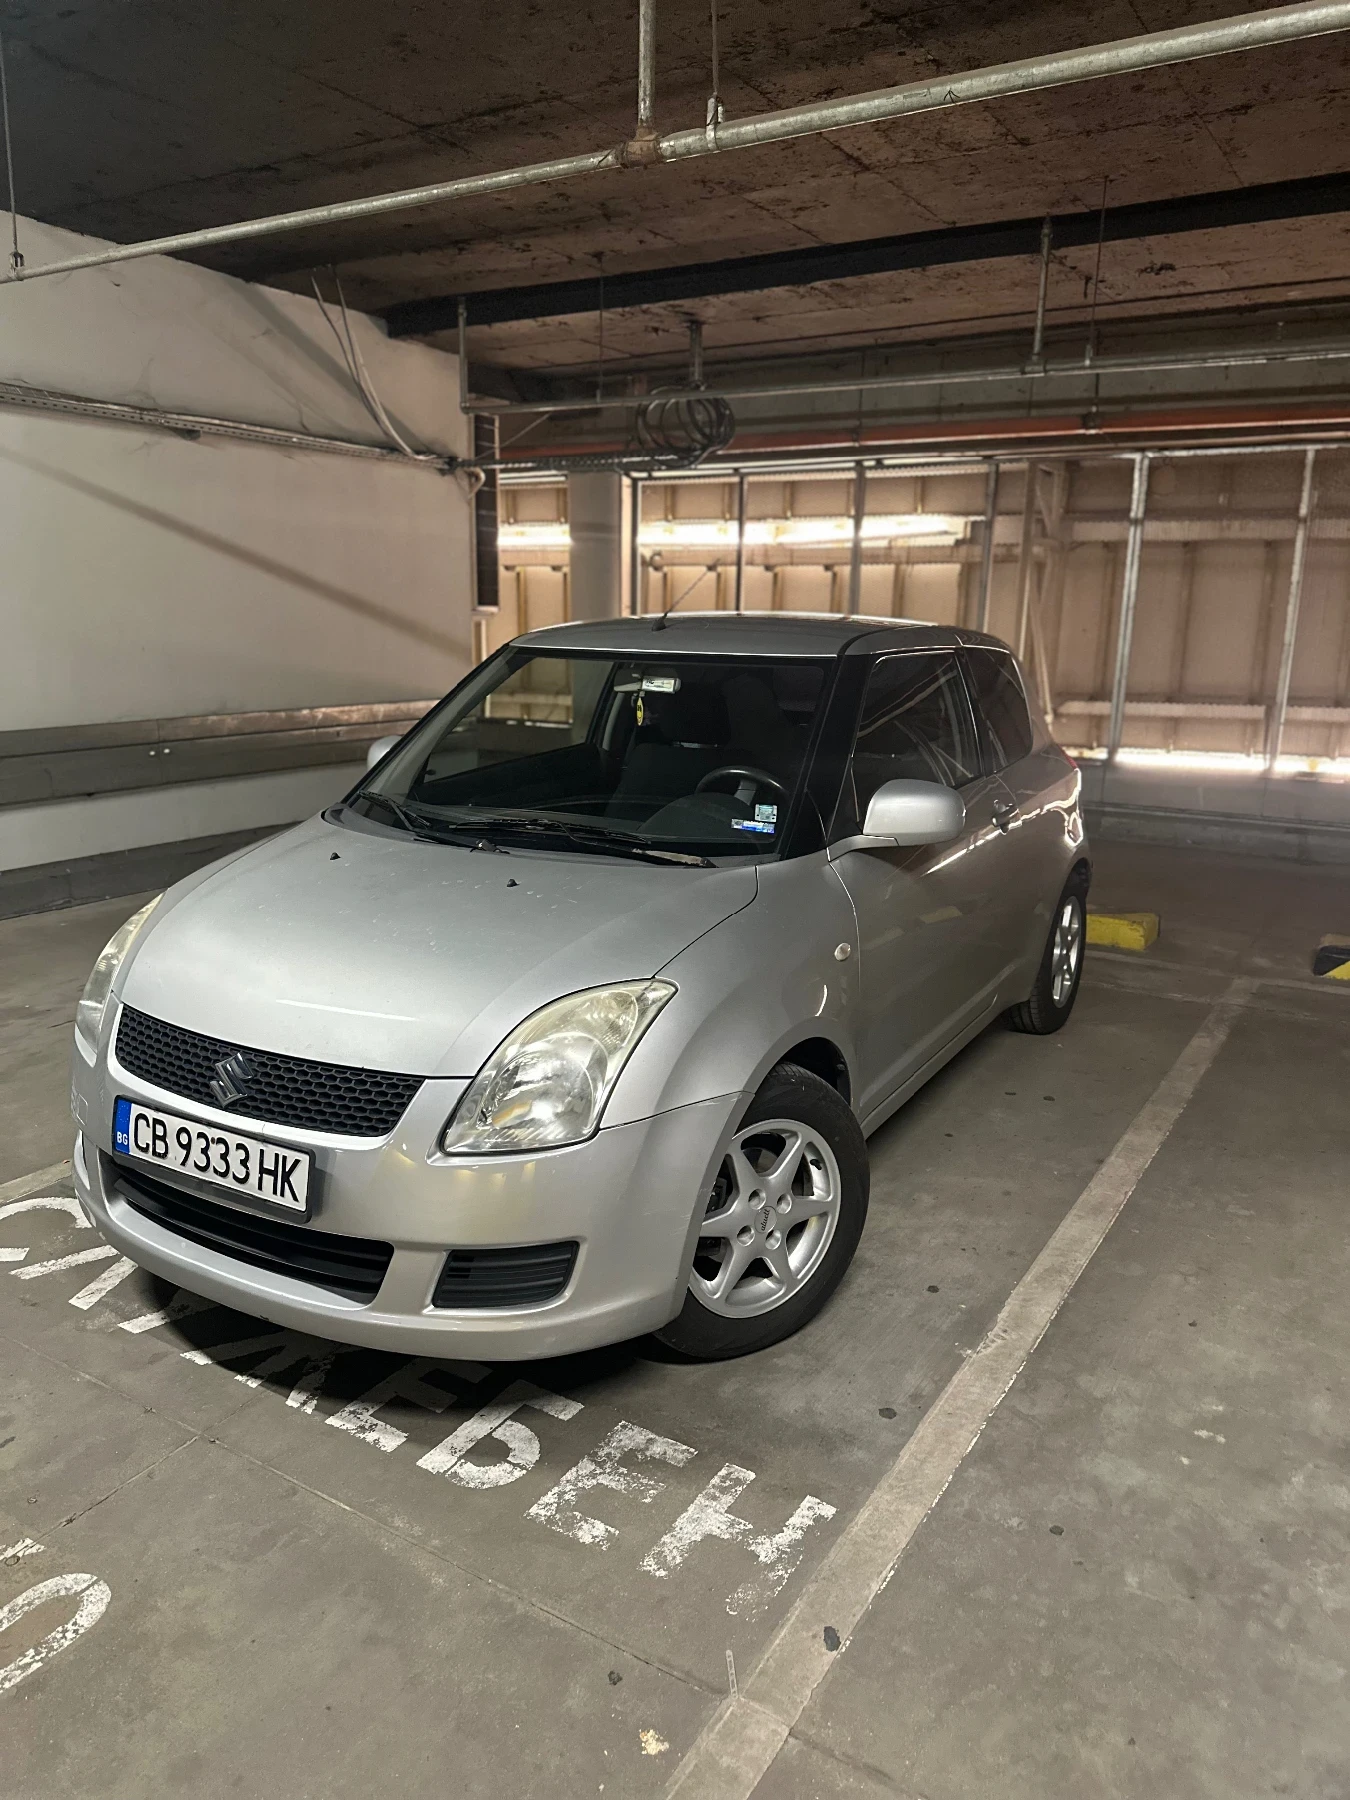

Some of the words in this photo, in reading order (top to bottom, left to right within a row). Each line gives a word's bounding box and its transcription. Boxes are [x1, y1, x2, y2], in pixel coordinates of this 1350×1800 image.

[117, 1131, 129, 1146] BG
[133, 1112, 169, 1160] CB
[175, 1126, 251, 1185] 9333
[257, 1148, 302, 1203] HK
